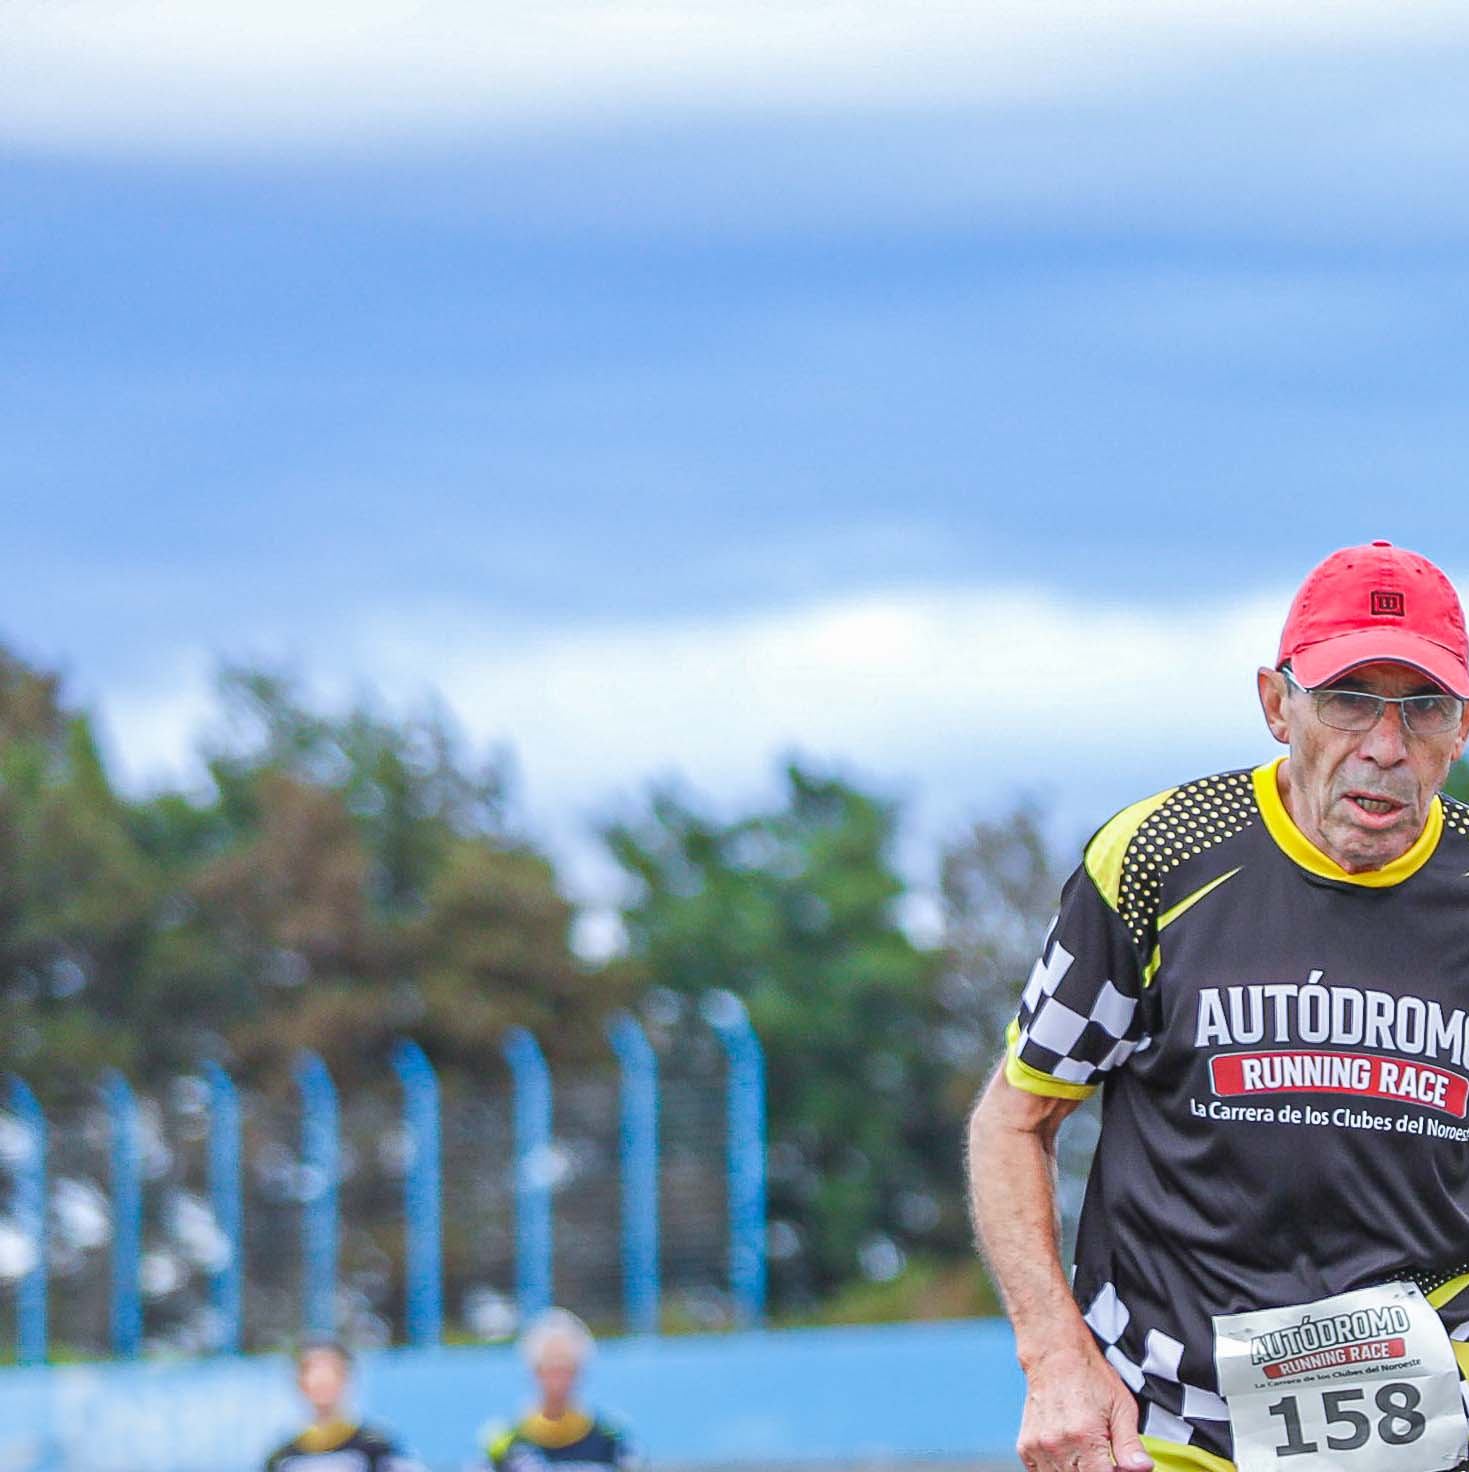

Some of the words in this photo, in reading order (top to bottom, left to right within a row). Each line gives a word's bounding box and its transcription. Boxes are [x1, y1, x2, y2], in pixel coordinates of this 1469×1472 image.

[1241, 1056, 1373, 1091] RUNNING
[1378, 1059, 1450, 1108] RACE
[1190, 1098, 1206, 1117] La
[1209, 1101, 1275, 1123] Carrera
[1278, 1104, 1301, 1124] de
[1305, 1105, 1330, 1126] los
[1332, 1108, 1393, 1131] Clubes
[1395, 1114, 1425, 1135] del
[1250, 1305, 1411, 1366] AUTÓDROMO
[1279, 1350, 1346, 1375] RUNNING
[1350, 1342, 1390, 1361] RACE
[1268, 1382, 1427, 1457] 158
